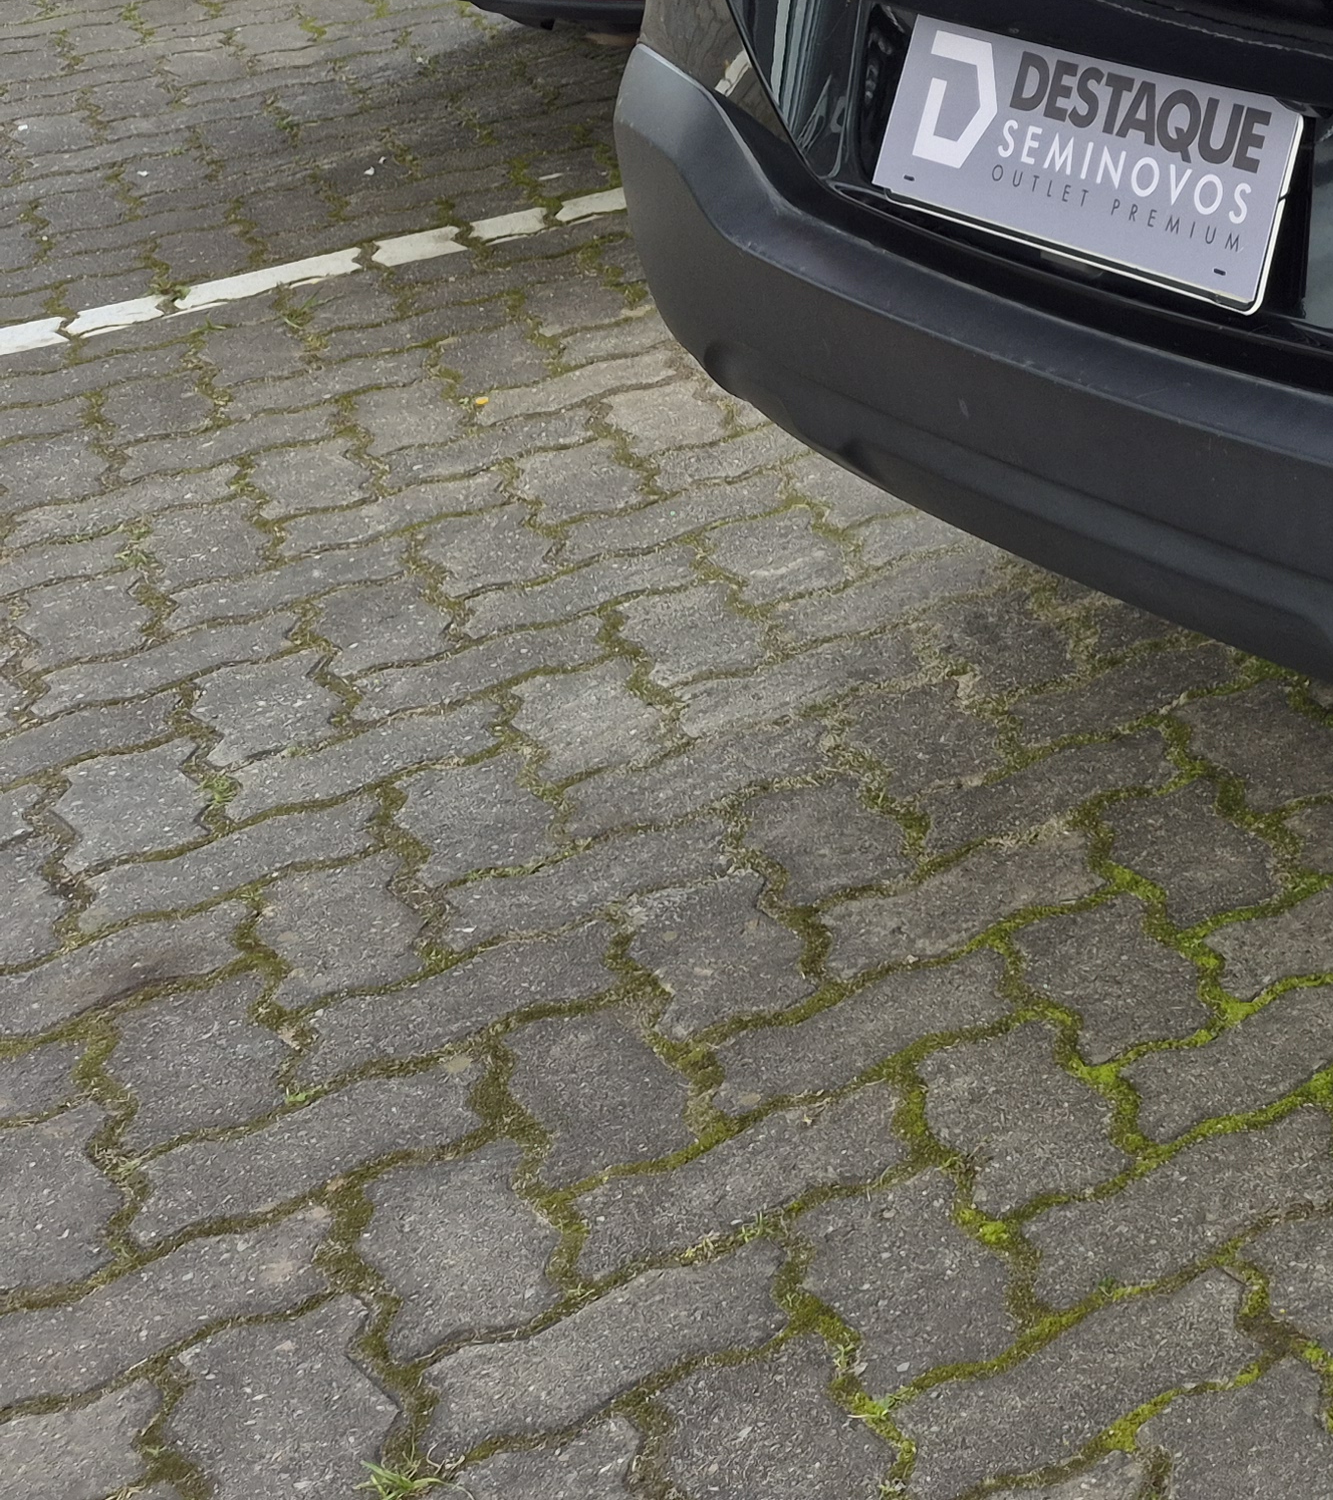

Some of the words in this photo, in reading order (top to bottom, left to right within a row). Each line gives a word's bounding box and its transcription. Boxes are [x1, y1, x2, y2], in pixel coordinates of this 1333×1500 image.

[1008, 49, 1273, 174] DESTAQUE
[990, 163, 1090, 208] OUTLET
[1110, 197, 1244, 253] PREMIUM
[996, 118, 1252, 225] SEMINOVOS
